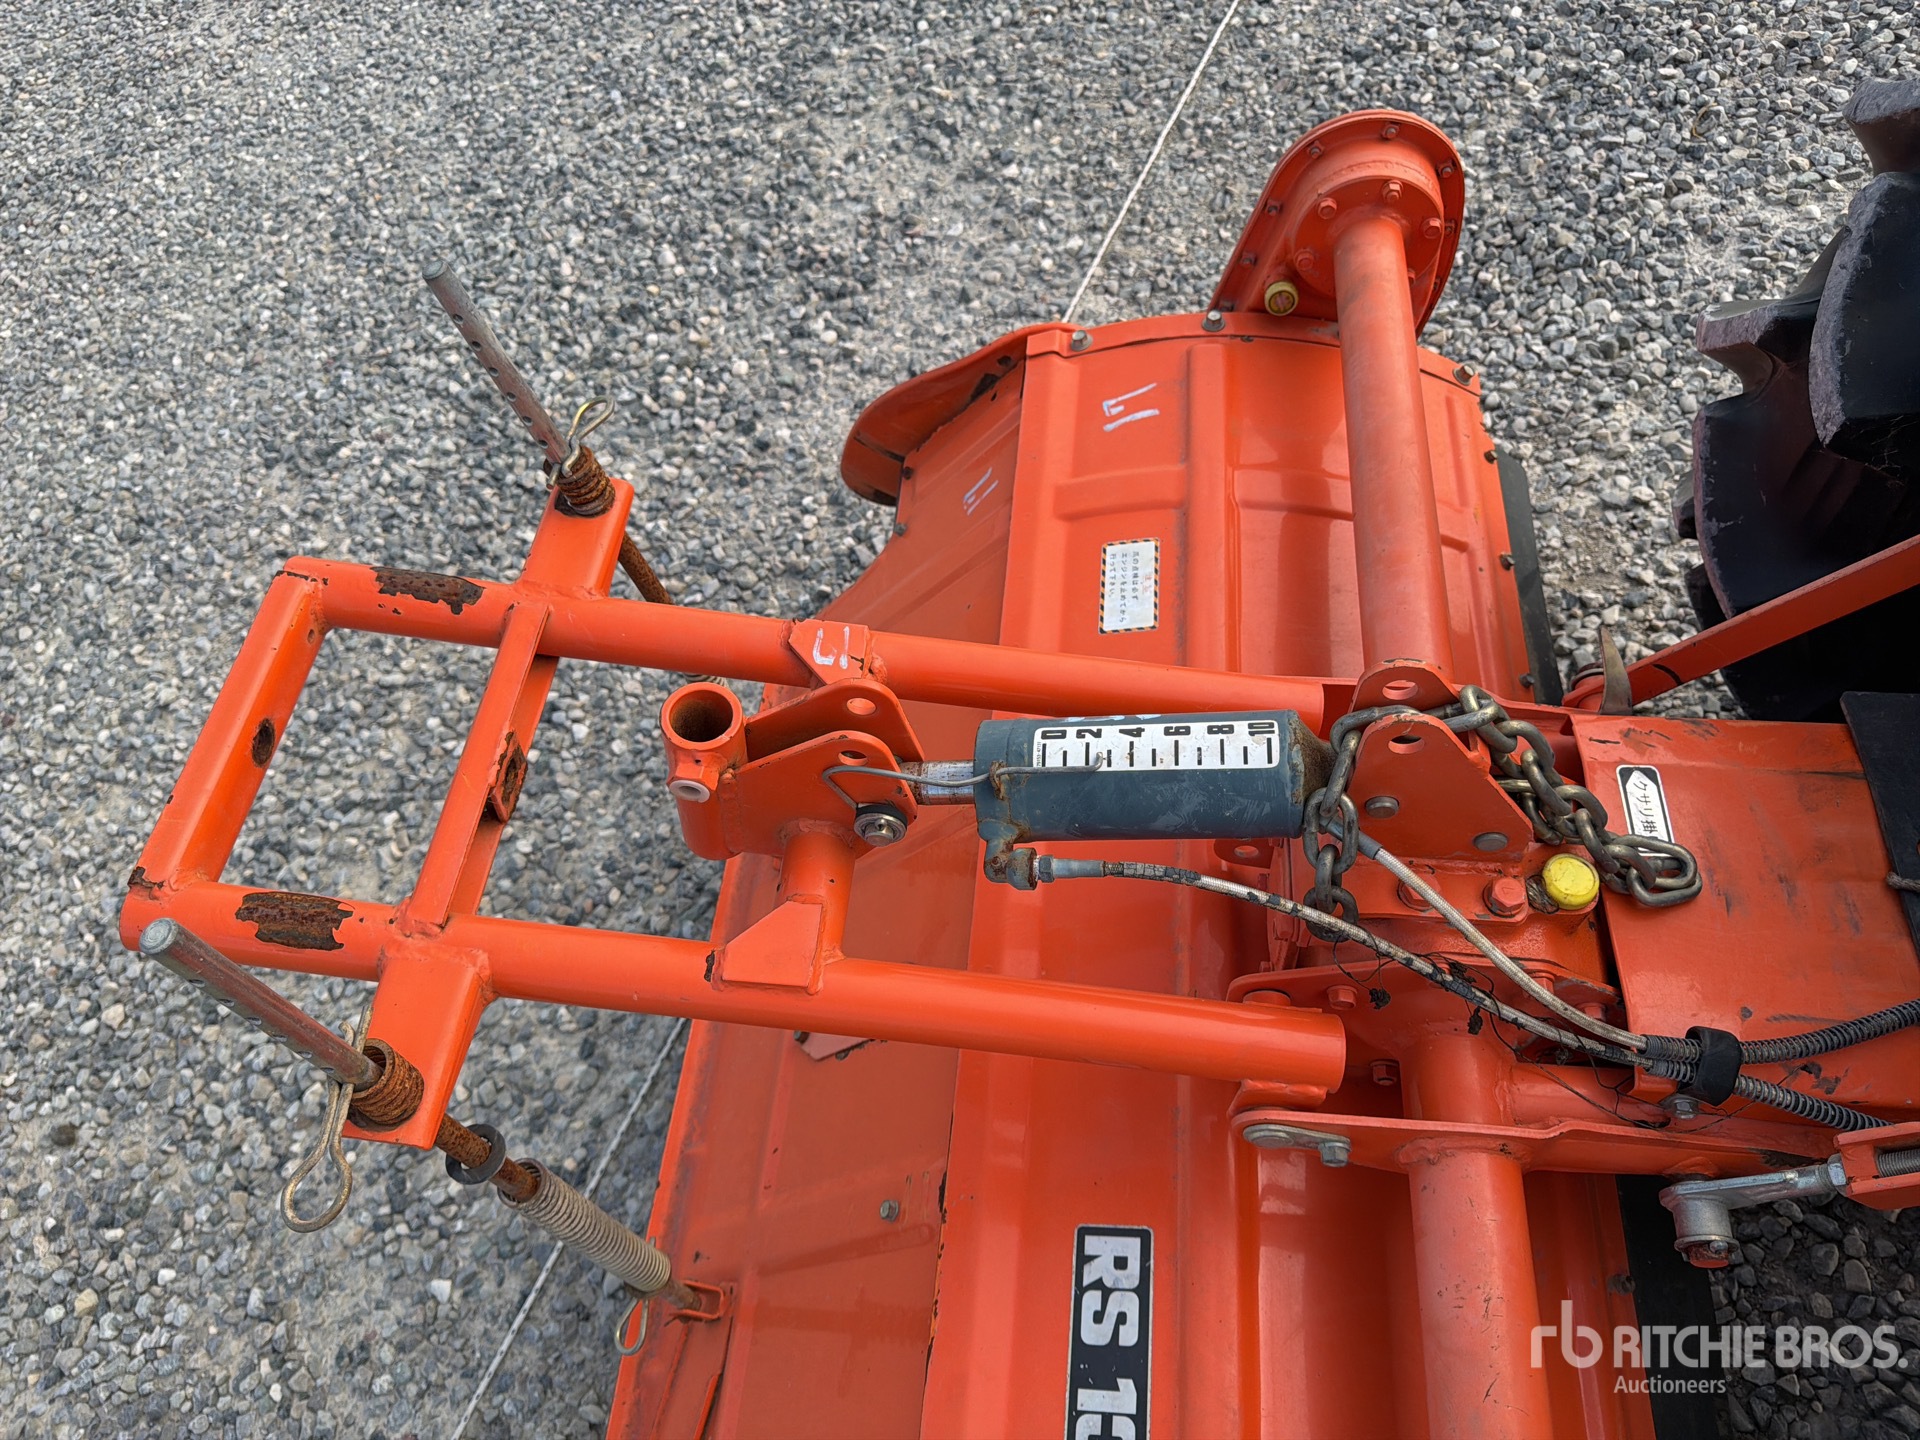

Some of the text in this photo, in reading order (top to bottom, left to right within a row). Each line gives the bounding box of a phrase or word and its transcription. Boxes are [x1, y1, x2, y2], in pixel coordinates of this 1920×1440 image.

[1076, 728, 1102, 739] 2
[1119, 727, 1145, 738] 4
[1164, 725, 1190, 736] 6
[1207, 724, 1234, 735] 8
[1248, 721, 1276, 736] 10
[1041, 729, 1067, 740] 0
[1633, 781, 1658, 838] クサリ掛
[1080, 1235, 1141, 1347] RS
